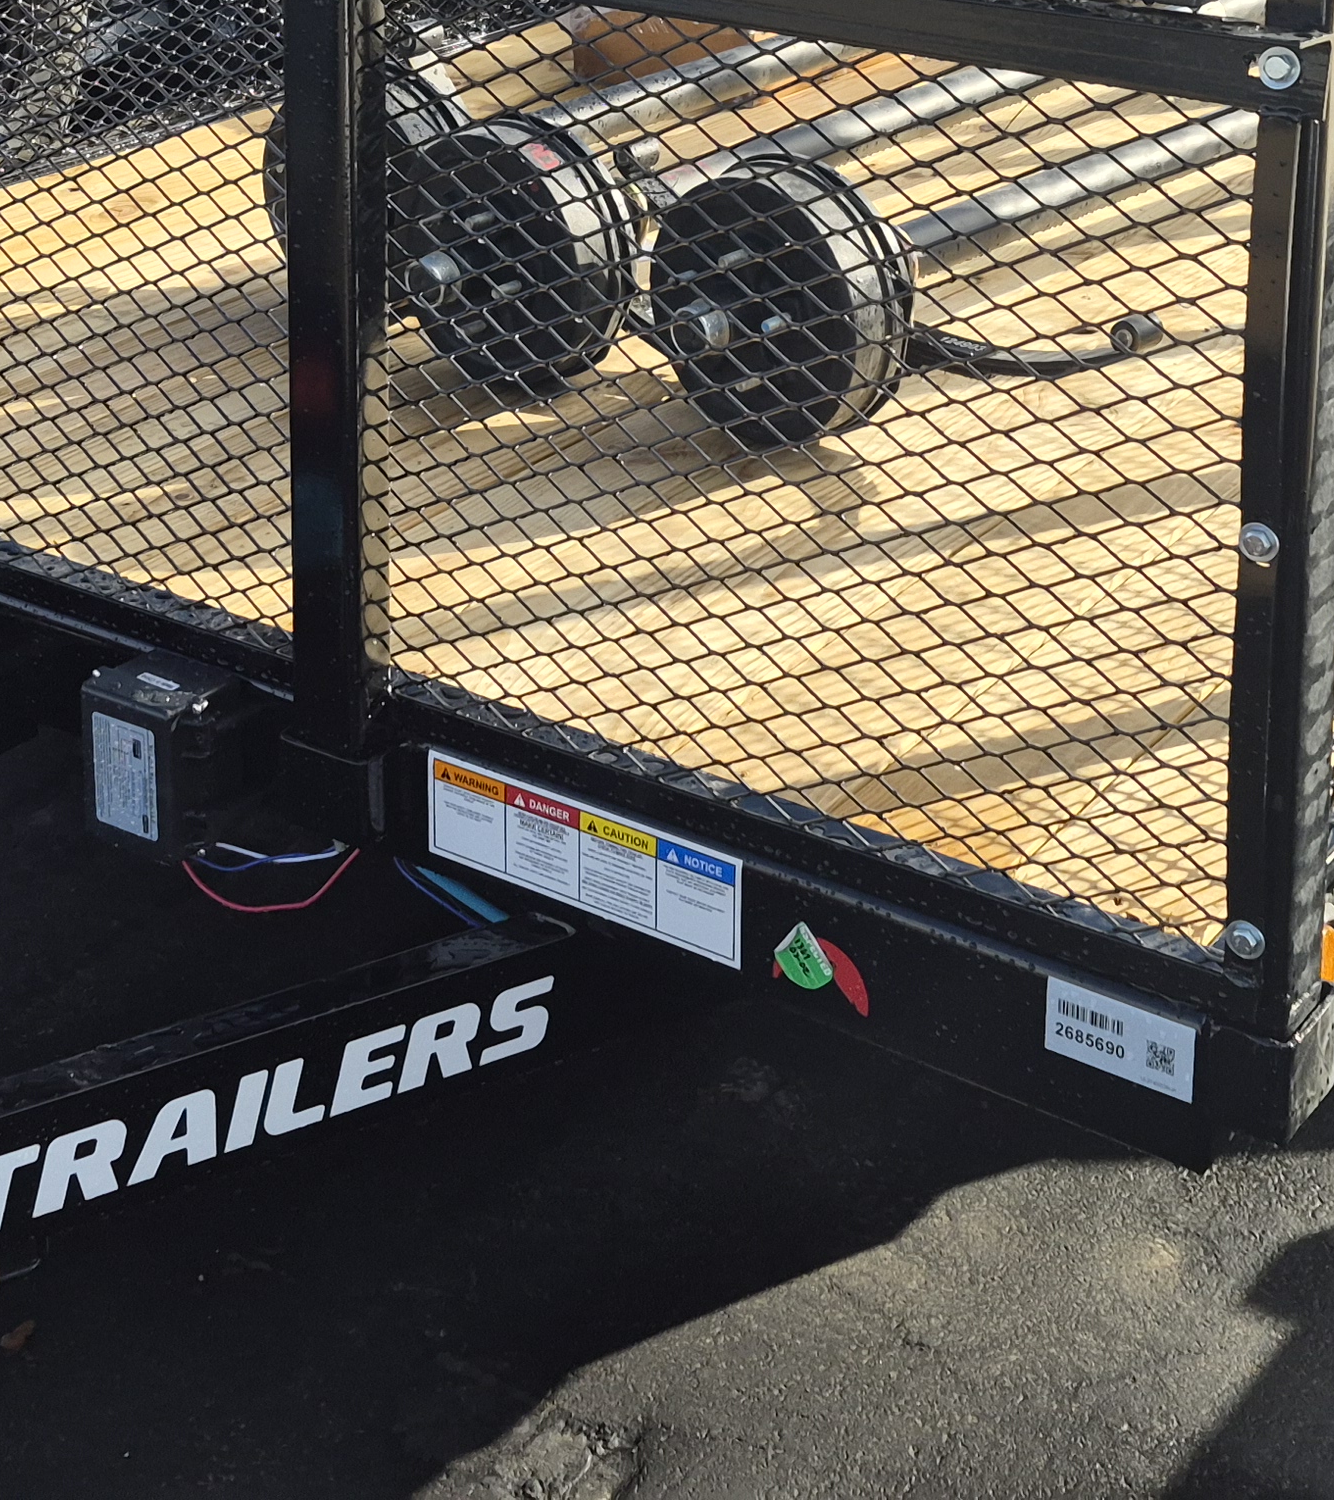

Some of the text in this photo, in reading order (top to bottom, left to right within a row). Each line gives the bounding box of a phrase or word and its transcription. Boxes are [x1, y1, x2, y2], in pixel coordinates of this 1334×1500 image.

[454, 771, 499, 797] WARNING
[529, 797, 570, 822] DANGER
[602, 825, 649, 851] CAUTION
[683, 854, 723, 878] NOTICE
[1055, 1022, 1125, 1060] 2685690
